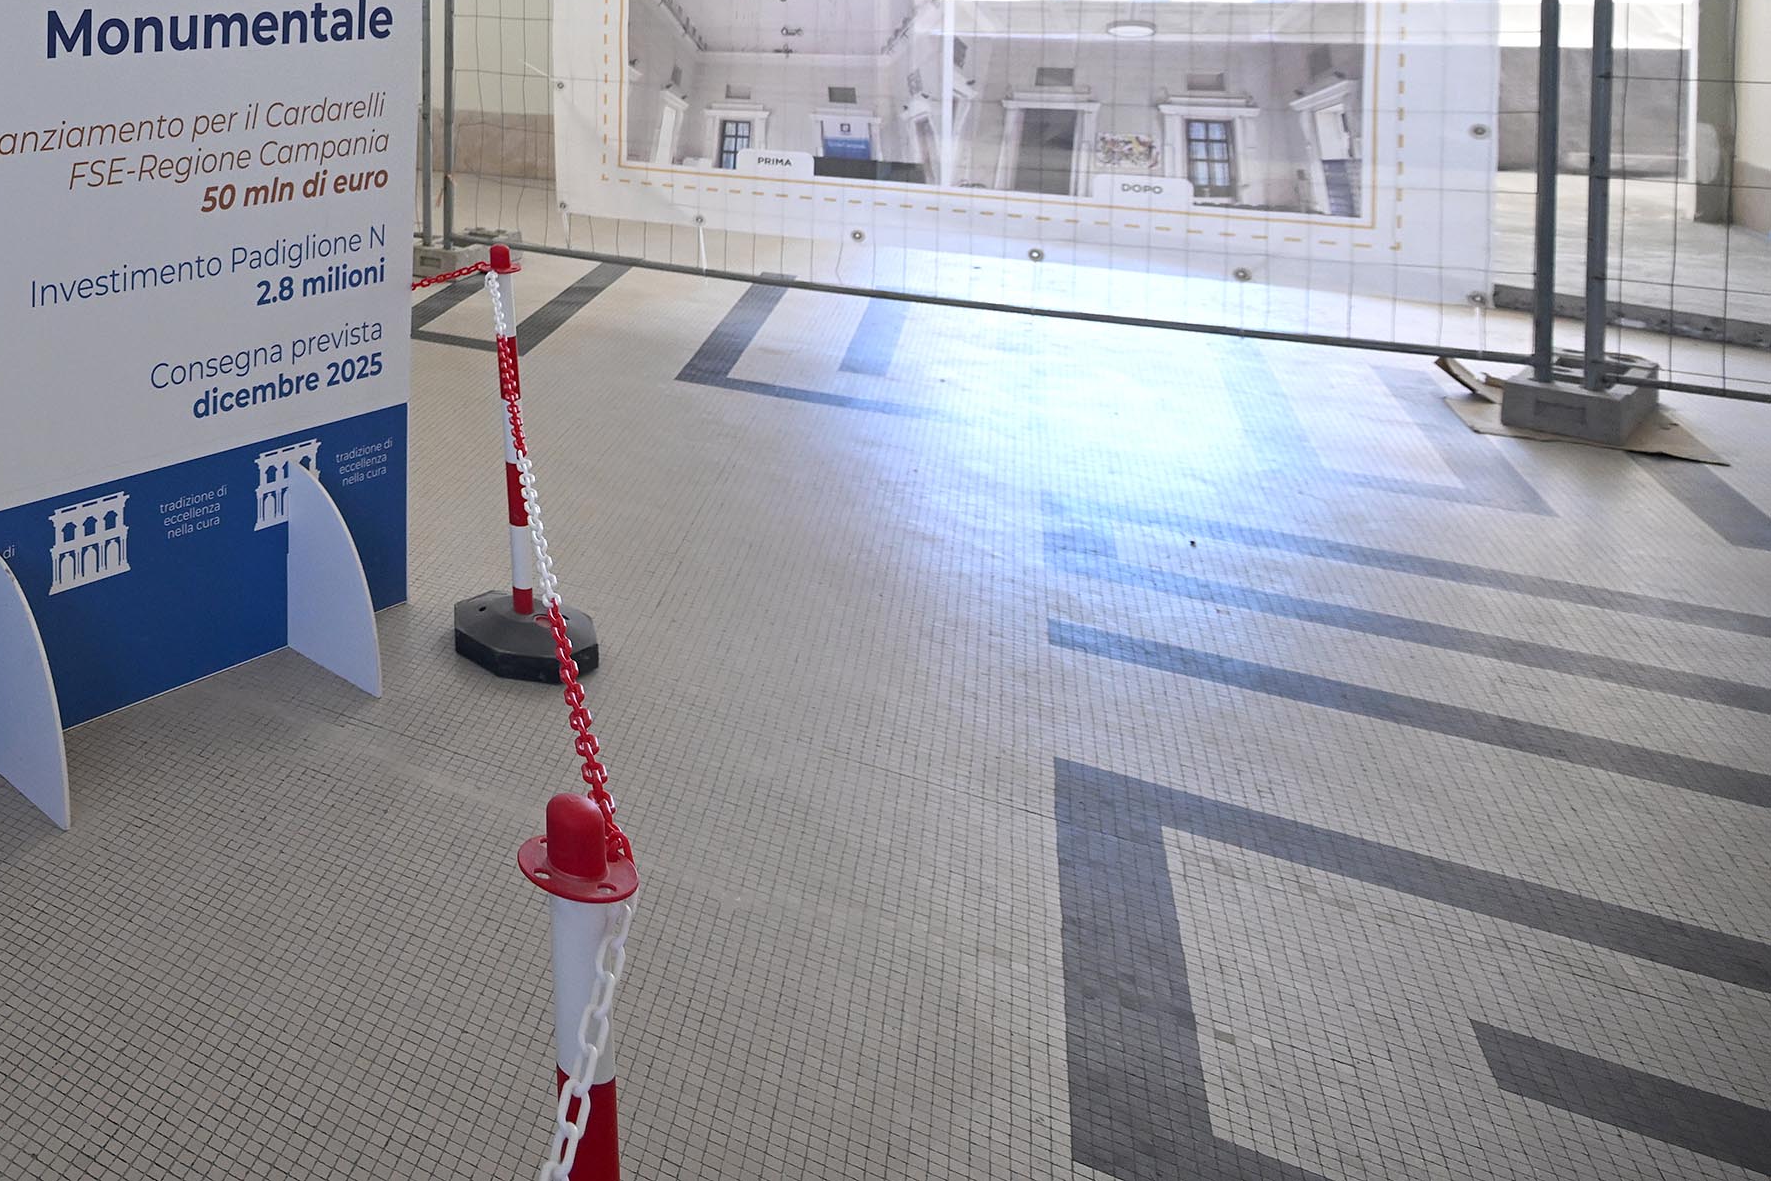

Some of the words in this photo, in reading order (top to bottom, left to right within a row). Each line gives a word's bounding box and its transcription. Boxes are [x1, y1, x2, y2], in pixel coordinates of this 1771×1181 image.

[191, 106, 237, 142] per
[244, 102, 259, 130] il
[265, 92, 387, 127] Cardarelli
[68, 149, 252, 191] FSE-Regione
[259, 130, 389, 168] Campania
[757, 156, 793, 167] PRIMA
[200, 183, 236, 213] 50
[243, 176, 293, 207] mln
[302, 170, 327, 199] di
[333, 167, 389, 193] euro
[1121, 183, 1163, 194] DOPO
[31, 257, 223, 308] Investimento
[231, 233, 362, 275] Padiglione
[370, 224, 386, 251] N
[256, 275, 295, 306] 2.8
[302, 258, 385, 298] milioni
[150, 339, 283, 390] Consegna
[291, 321, 383, 363] prevista
[193, 368, 320, 419] dicembre
[326, 351, 383, 388] 2025
[335, 443, 382, 463] tradizione
[383, 437, 393, 449] di
[339, 453, 388, 474] eccellenza
[342, 472, 365, 487] nella
[366, 466, 387, 479] cura
[159, 491, 215, 514] tradizione
[216, 484, 228, 497] di
[163, 502, 221, 526] eccellenza
[167, 523, 194, 539] nella
[196, 516, 221, 530] cura
[2, 544, 15, 559] di
